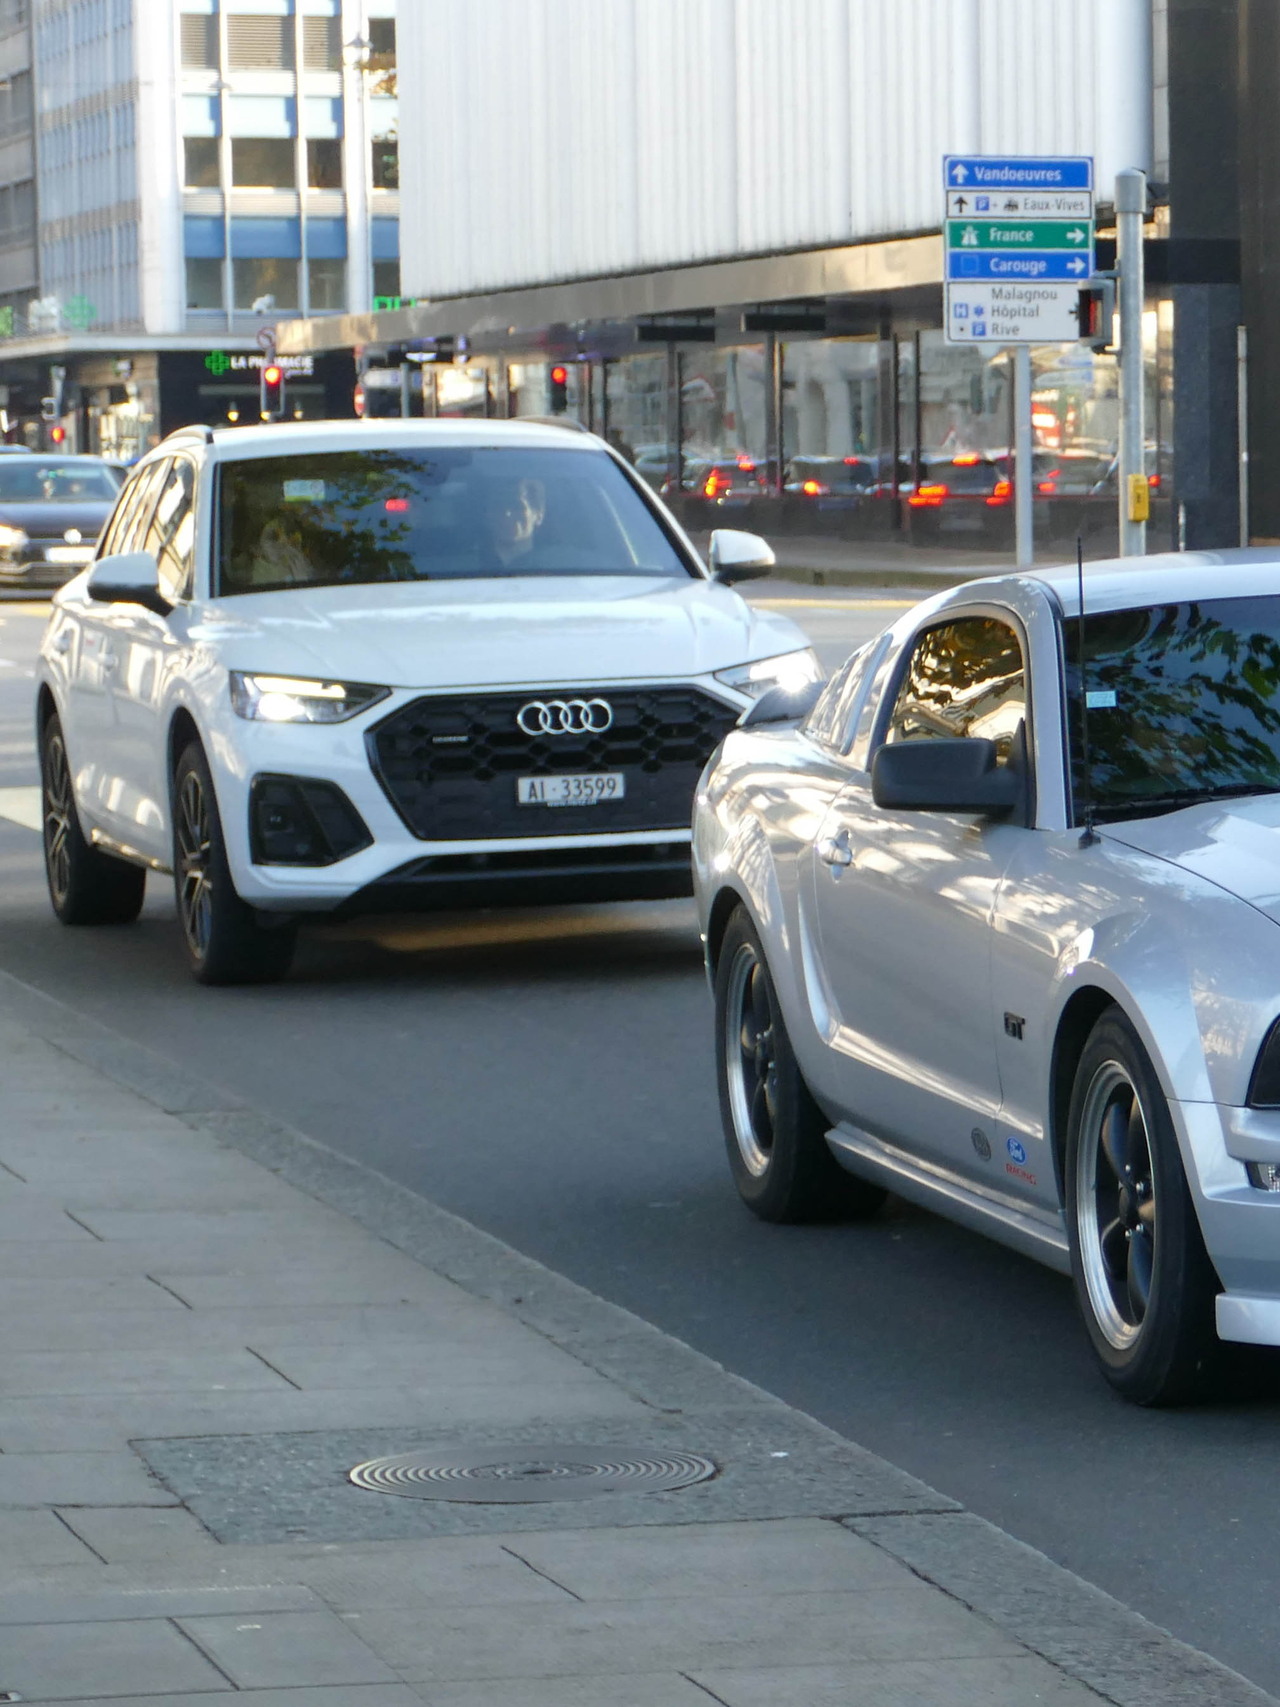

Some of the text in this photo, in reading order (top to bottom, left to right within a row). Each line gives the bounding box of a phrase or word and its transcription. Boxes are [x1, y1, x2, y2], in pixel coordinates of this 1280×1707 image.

[974, 166, 1062, 181] Vandoeuvres
[1023, 198, 1085, 211] Eaux-Vives
[989, 227, 1034, 242] France
[989, 257, 1047, 276] Carouge
[991, 287, 1058, 303] Malagnou
[991, 305, 1040, 319] Hôpital
[991, 323, 1020, 335] Rive
[230, 355, 247, 370] LA
[561, 777, 617, 798] 33599
[1004, 1012, 1026, 1040] GT
